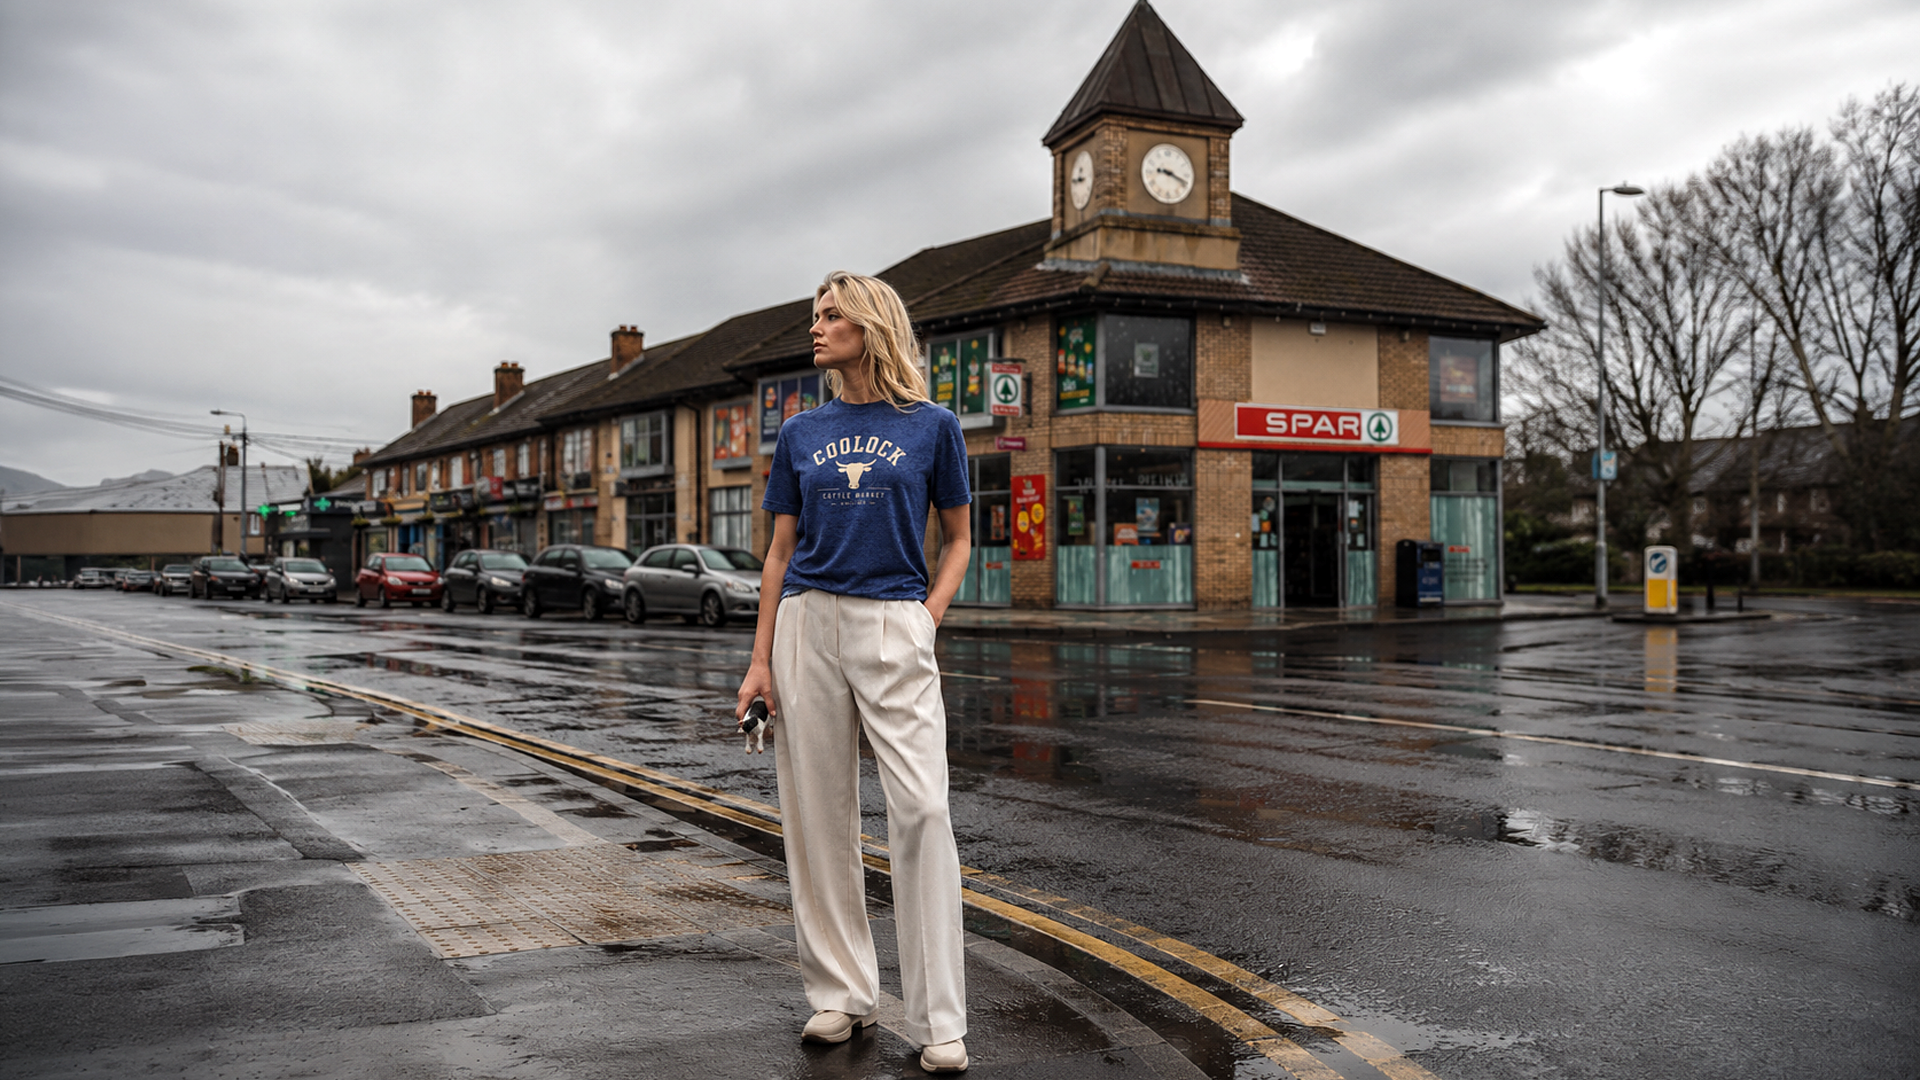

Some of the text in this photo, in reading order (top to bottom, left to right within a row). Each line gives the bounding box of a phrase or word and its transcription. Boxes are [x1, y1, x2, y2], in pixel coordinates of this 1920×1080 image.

[1265, 412, 1360, 436] SPAR
[812, 436, 906, 466] COOLOCK
[822, 492, 851, 500] CATTLE
